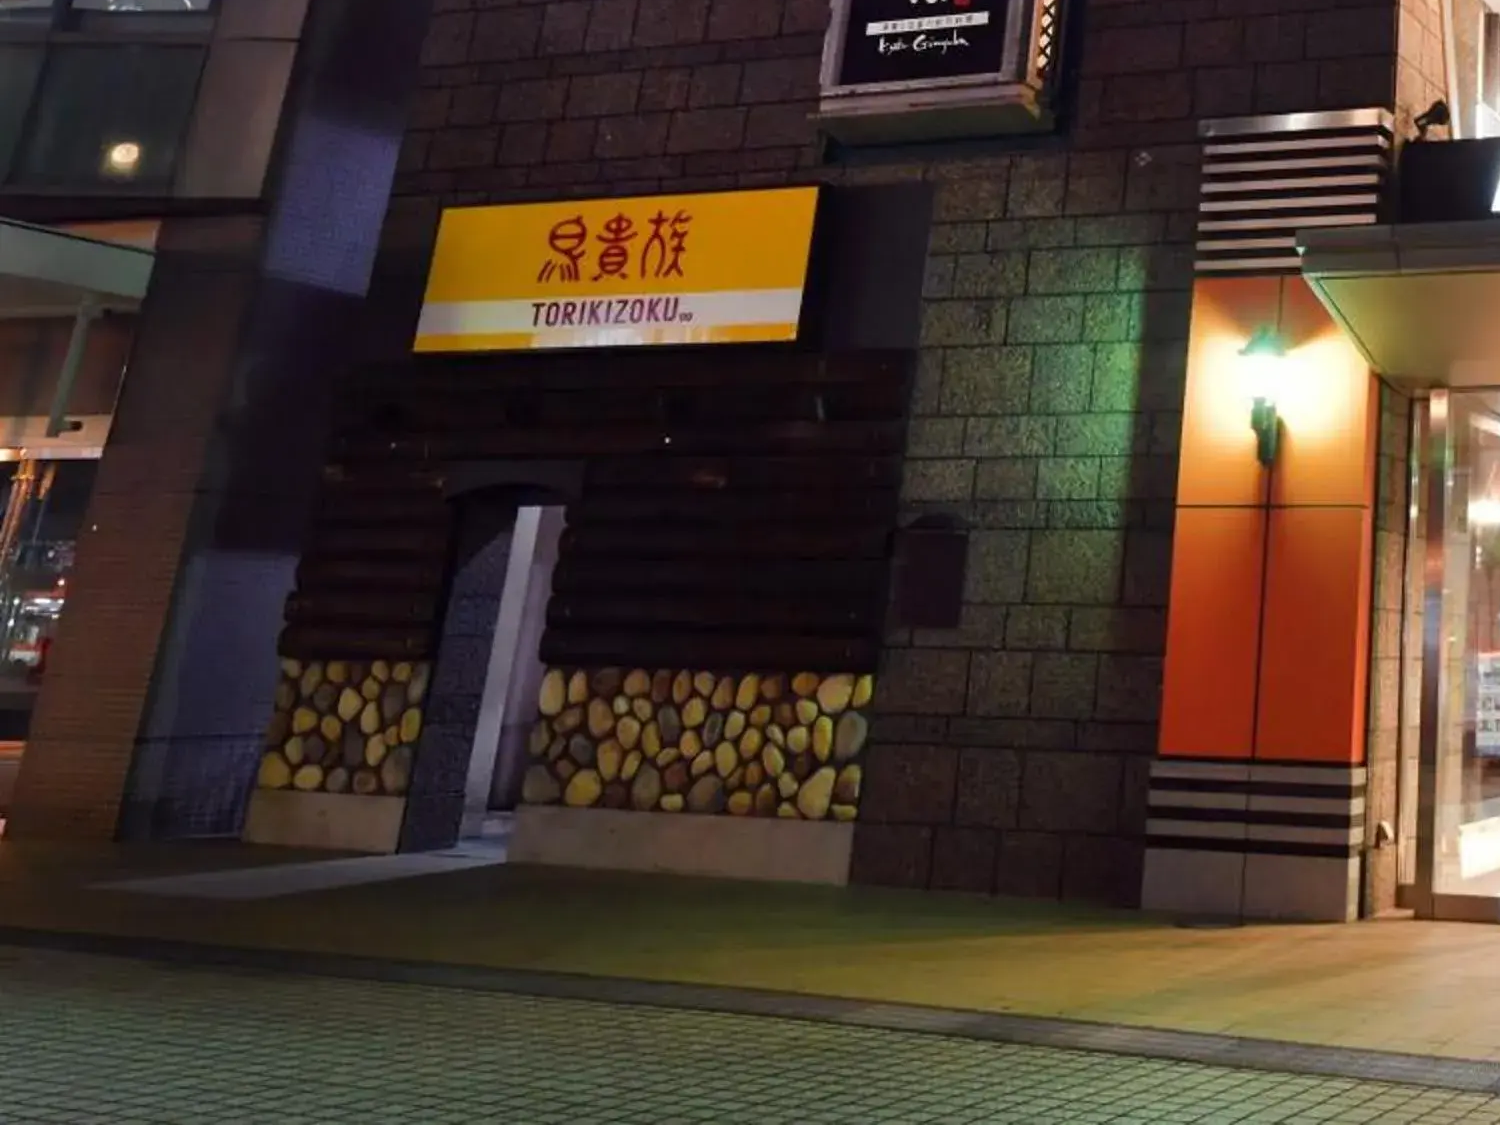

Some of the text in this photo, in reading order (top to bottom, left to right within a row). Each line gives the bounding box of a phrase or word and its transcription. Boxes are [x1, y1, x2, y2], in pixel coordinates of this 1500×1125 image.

[537, 209, 693, 283] 鳥貴族
[531, 296, 680, 328] TORIKIZOKU
